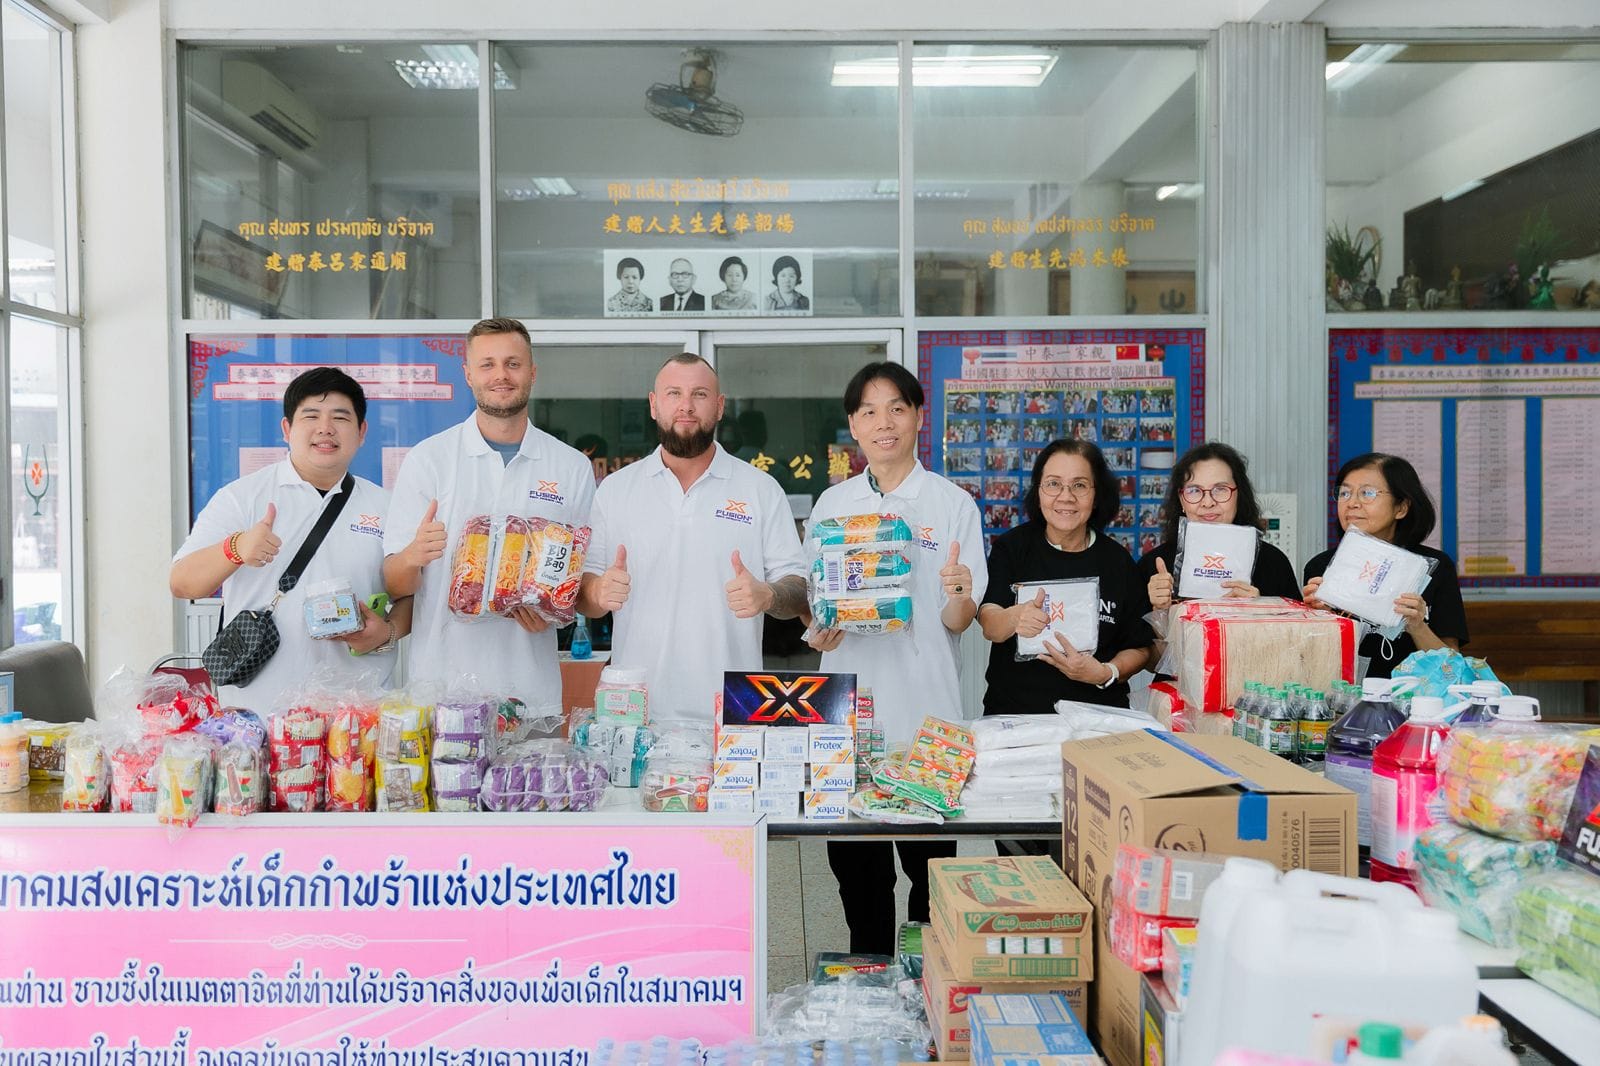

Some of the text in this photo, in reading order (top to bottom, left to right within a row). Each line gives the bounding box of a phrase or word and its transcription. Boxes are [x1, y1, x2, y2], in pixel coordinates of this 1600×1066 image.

[238, 219, 265, 241] คุณ
[388, 216, 434, 237] บริจาค
[545, 556, 565, 573] Bag
[813, 741, 843, 750] Protex
[729, 747, 758, 756] Protex
[724, 776, 754, 785] Protex
[823, 778, 853, 787] Protex
[816, 806, 845, 815] Protex
